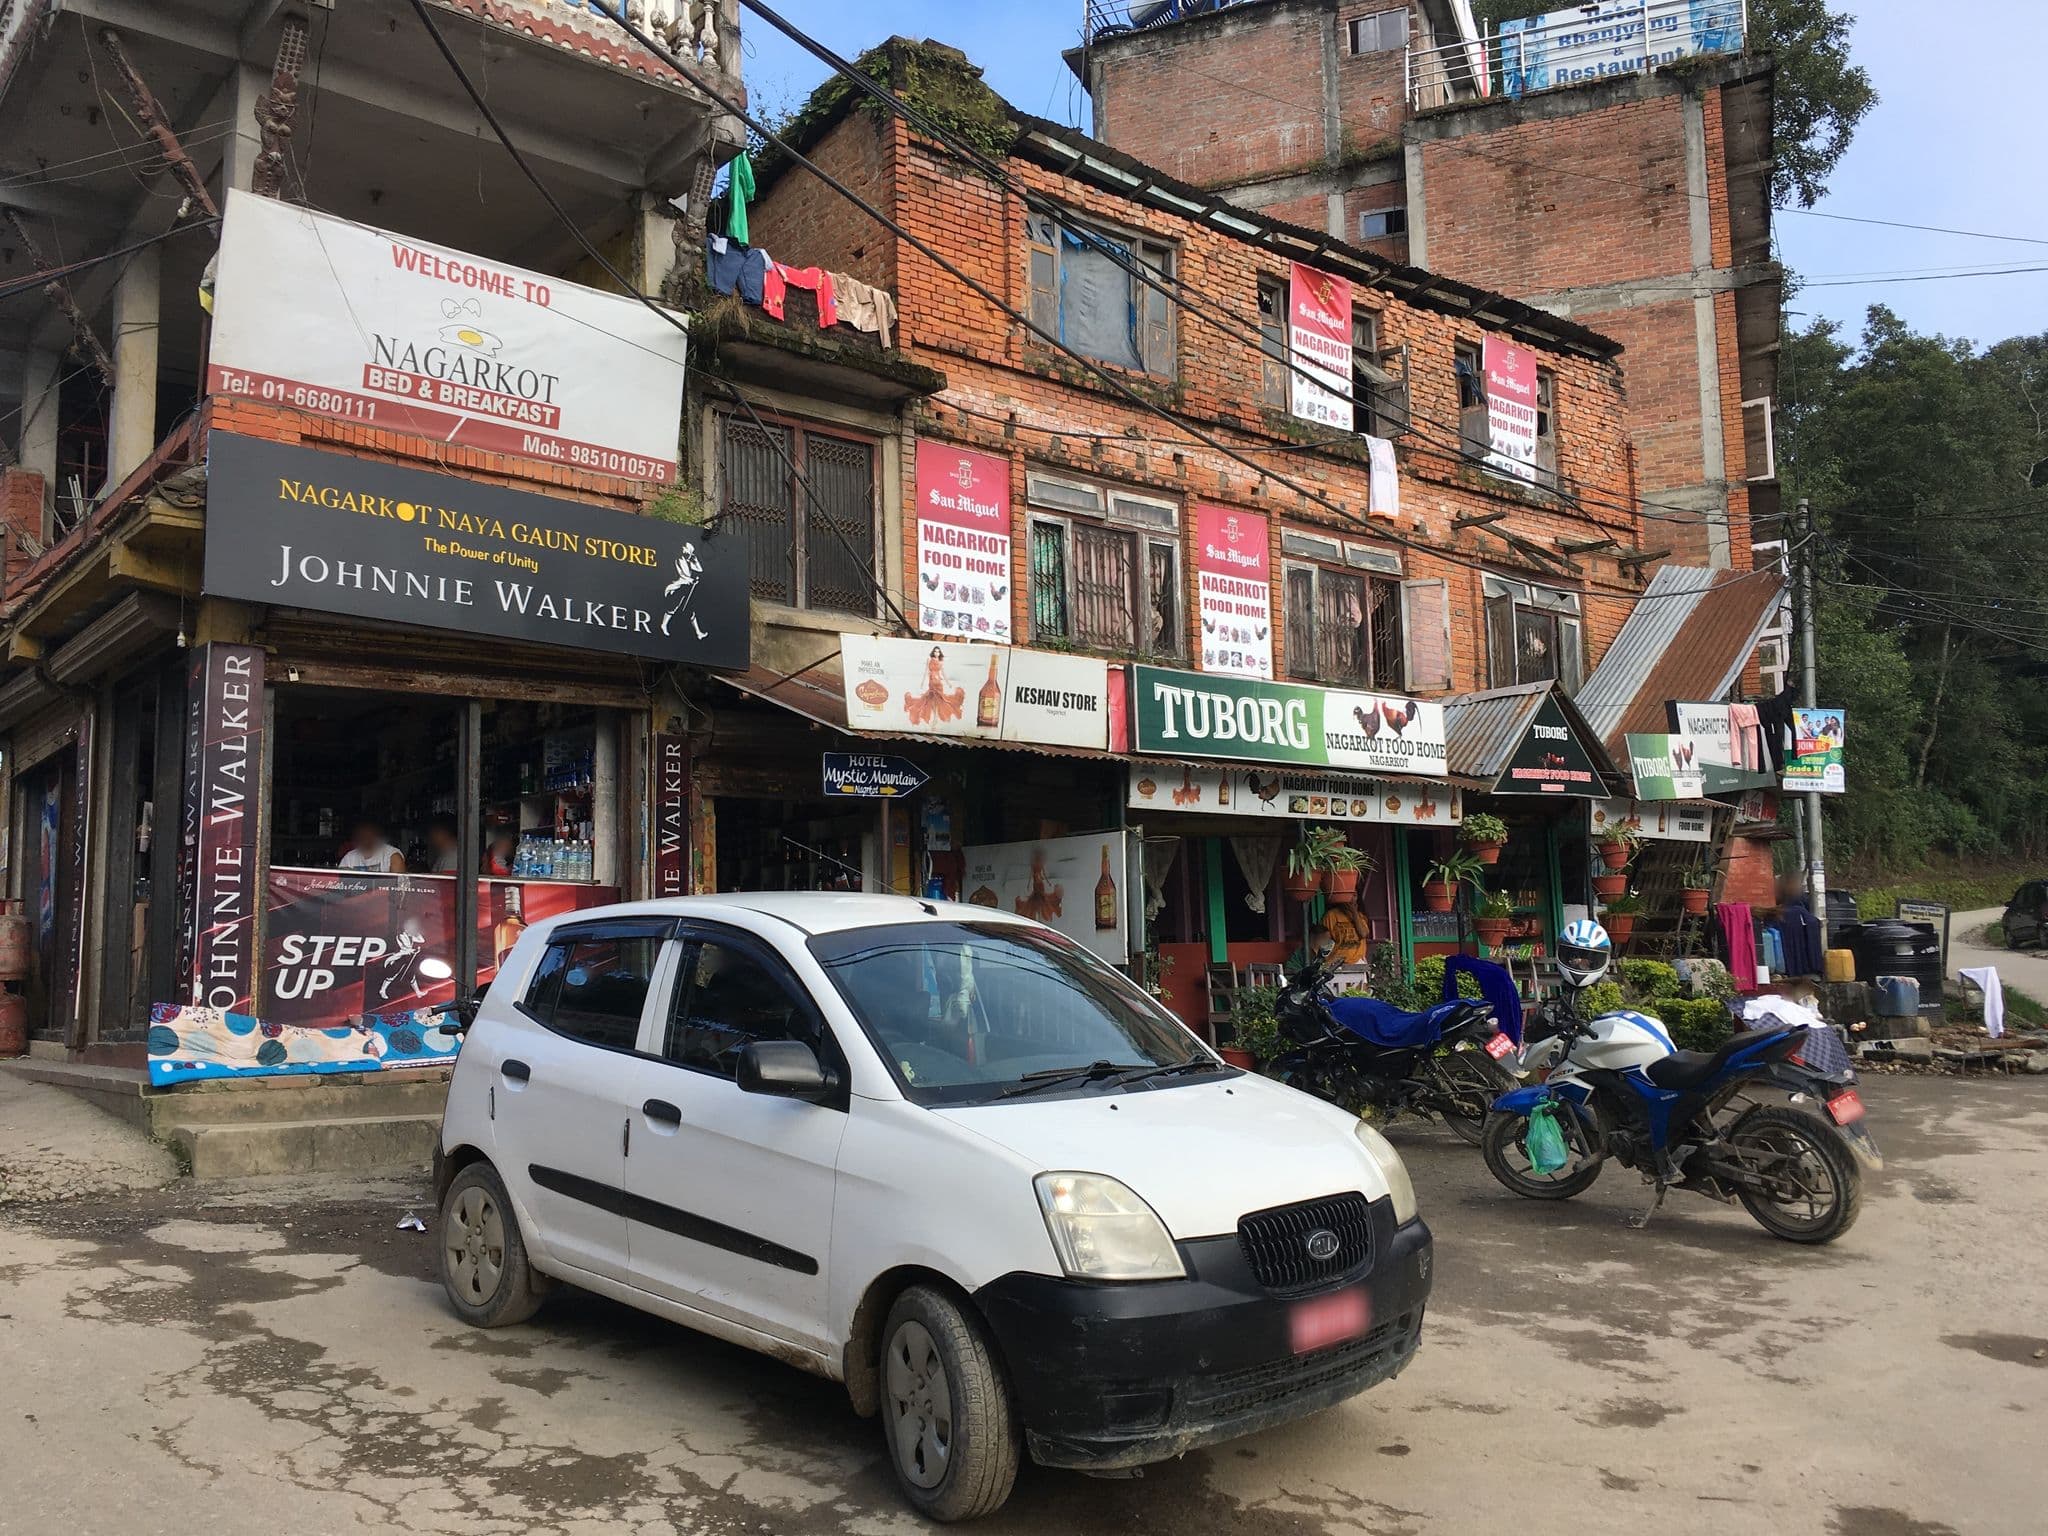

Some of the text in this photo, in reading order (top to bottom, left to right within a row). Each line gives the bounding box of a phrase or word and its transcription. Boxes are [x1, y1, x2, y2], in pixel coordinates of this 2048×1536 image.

[1556, 47, 1685, 83] Restaurant
[391, 244, 551, 307] WELCOME TO
[1299, 302, 1345, 330] San Miguel
[1295, 330, 1350, 362] NAGARKOT
[372, 333, 560, 404] NAGARKOT
[219, 370, 376, 421] Tel: 01-6680111
[368, 367, 556, 425] BED & BREAKFAST
[1488, 396, 1534, 423] NAGARKOT
[1509, 422, 1533, 439] HOME
[523, 434, 665, 481] Mob: 9851010575
[929, 488, 1000, 518] San Miguel
[278, 478, 658, 568] NAGARKOT NAYA GAUN STORE
[424, 537, 539, 573] The Power of Unity
[923, 524, 1008, 556] NAGARKOT
[1206, 543, 1260, 568] San Miguel
[924, 549, 1006, 577] FOOD HOME
[270, 544, 652, 634] JOHNNIE WALKER
[1202, 574, 1268, 600] NAGARKOT
[1203, 597, 1267, 619] FOOD HOME
[1015, 686, 1097, 712] KESHAV STORE
[1153, 682, 1310, 750] TUBORG
[1325, 733, 1446, 759] NAGARKOT FOOD HOME
[1533, 725, 1569, 741] TUBORG
[1797, 740, 1828, 751] JOIN US
[186, 700, 200, 832] WALKER
[849, 755, 888, 768] HOTEL
[1369, 755, 1409, 768] NAGARKOT
[1634, 757, 1672, 778] TUBORG
[824, 767, 920, 789] Mystic Mountain
[1282, 776, 1375, 797] NAGARKOT FOOD HOME
[661, 744, 681, 856] WALKER
[208, 655, 251, 1012] OHNNIE WALKER
[276, 934, 388, 967] STEP
[275, 968, 335, 1000] UP
